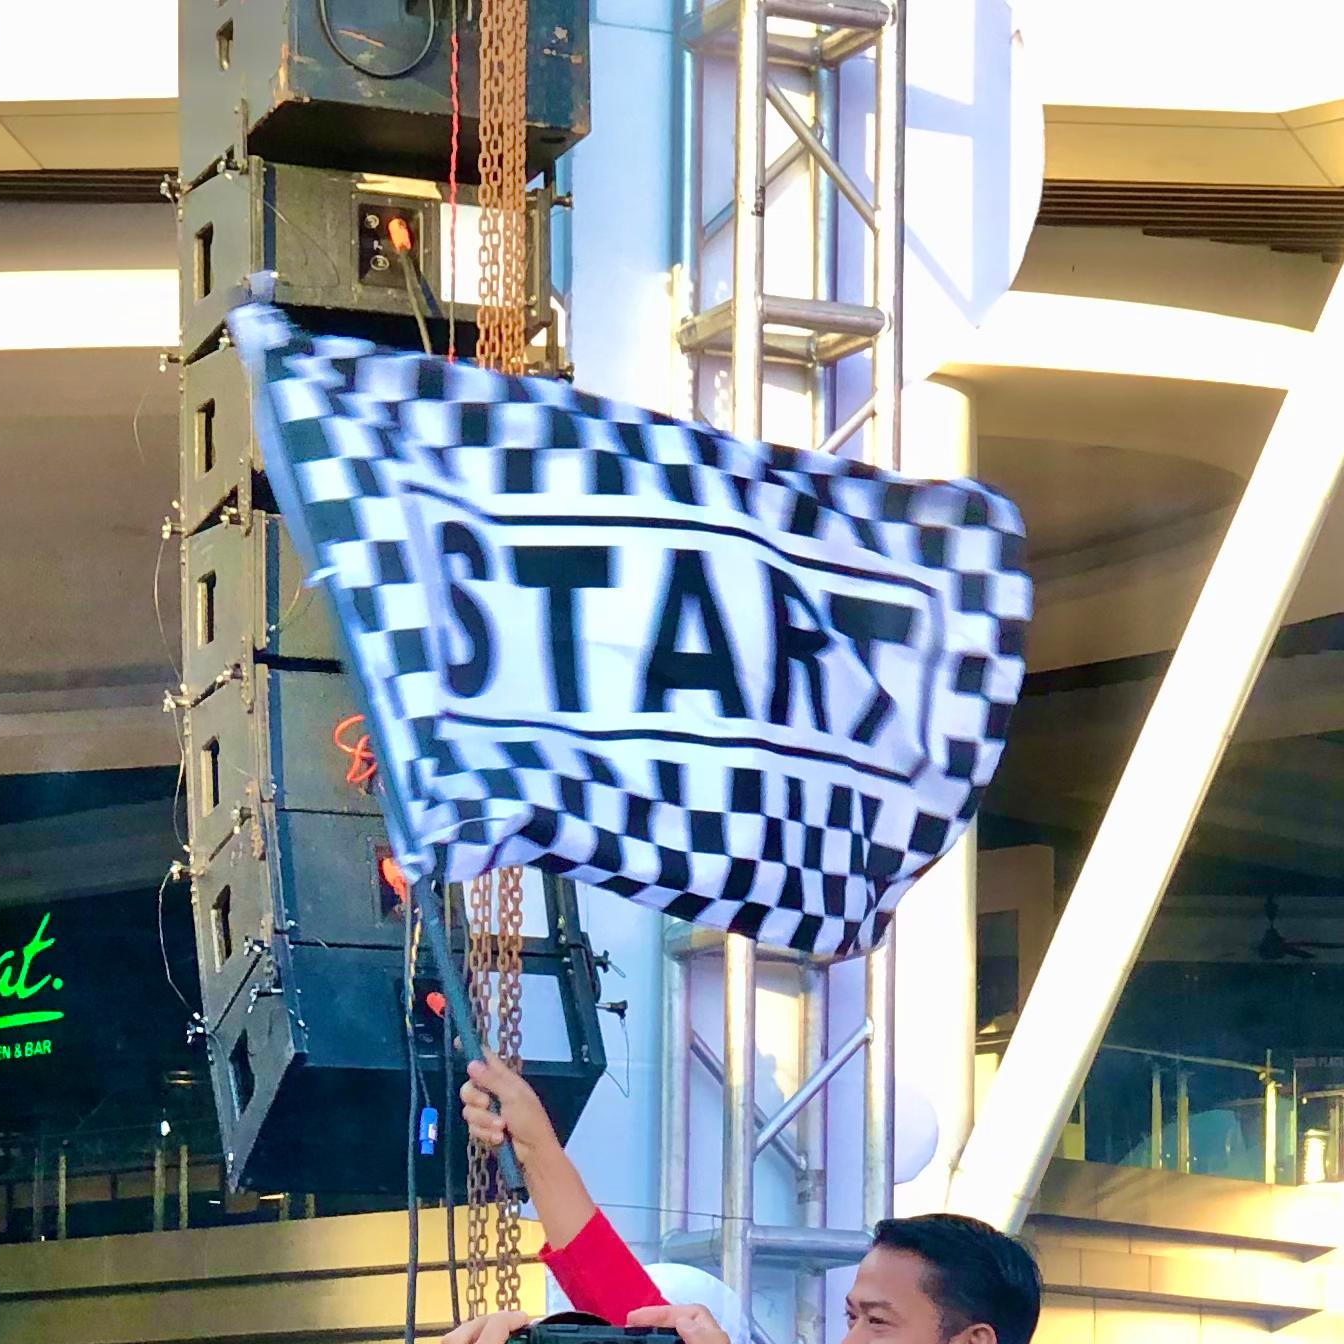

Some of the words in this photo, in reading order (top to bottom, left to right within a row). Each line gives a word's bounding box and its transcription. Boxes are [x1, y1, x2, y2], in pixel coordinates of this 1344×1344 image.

[435, 519, 915, 744] START
[14, 1043, 23, 1059] &
[25, 1040, 52, 1057] BAR
